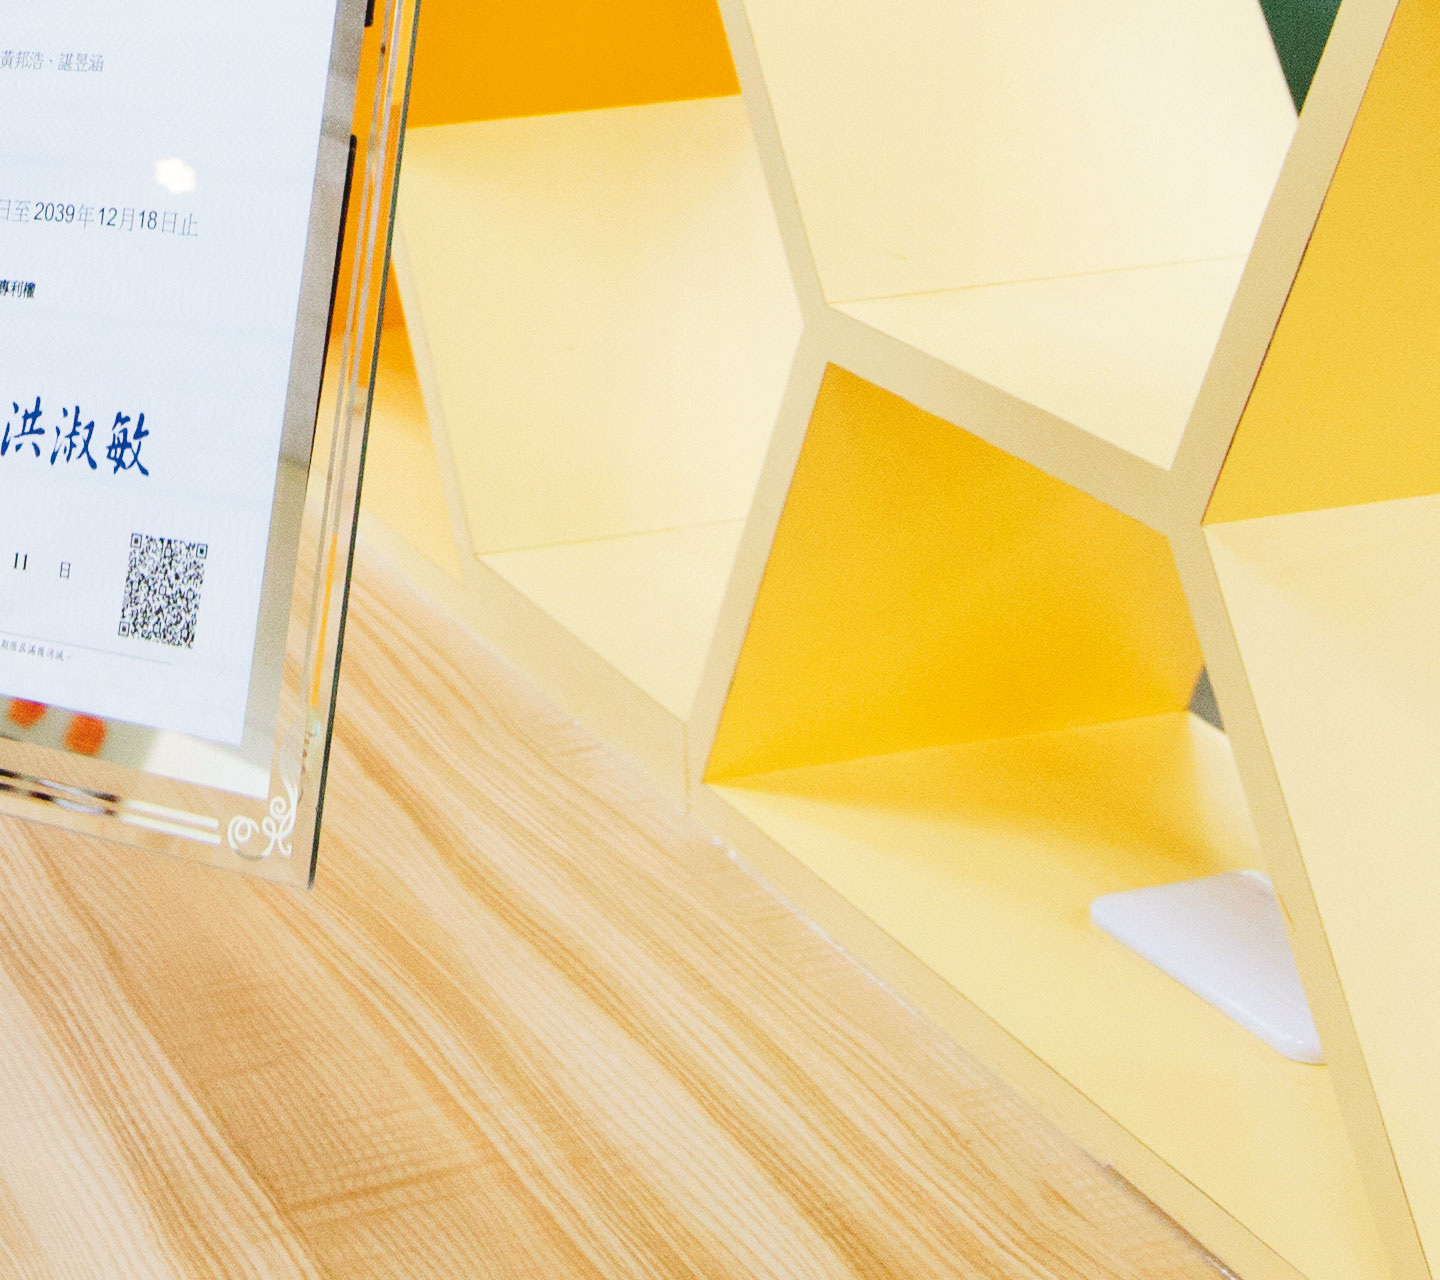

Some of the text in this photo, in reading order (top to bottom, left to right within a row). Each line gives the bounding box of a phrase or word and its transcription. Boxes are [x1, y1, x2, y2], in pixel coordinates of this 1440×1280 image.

[0, 395, 151, 477] 洪淑敏
[13, 552, 29, 571] 11
[59, 561, 71, 580] 日
